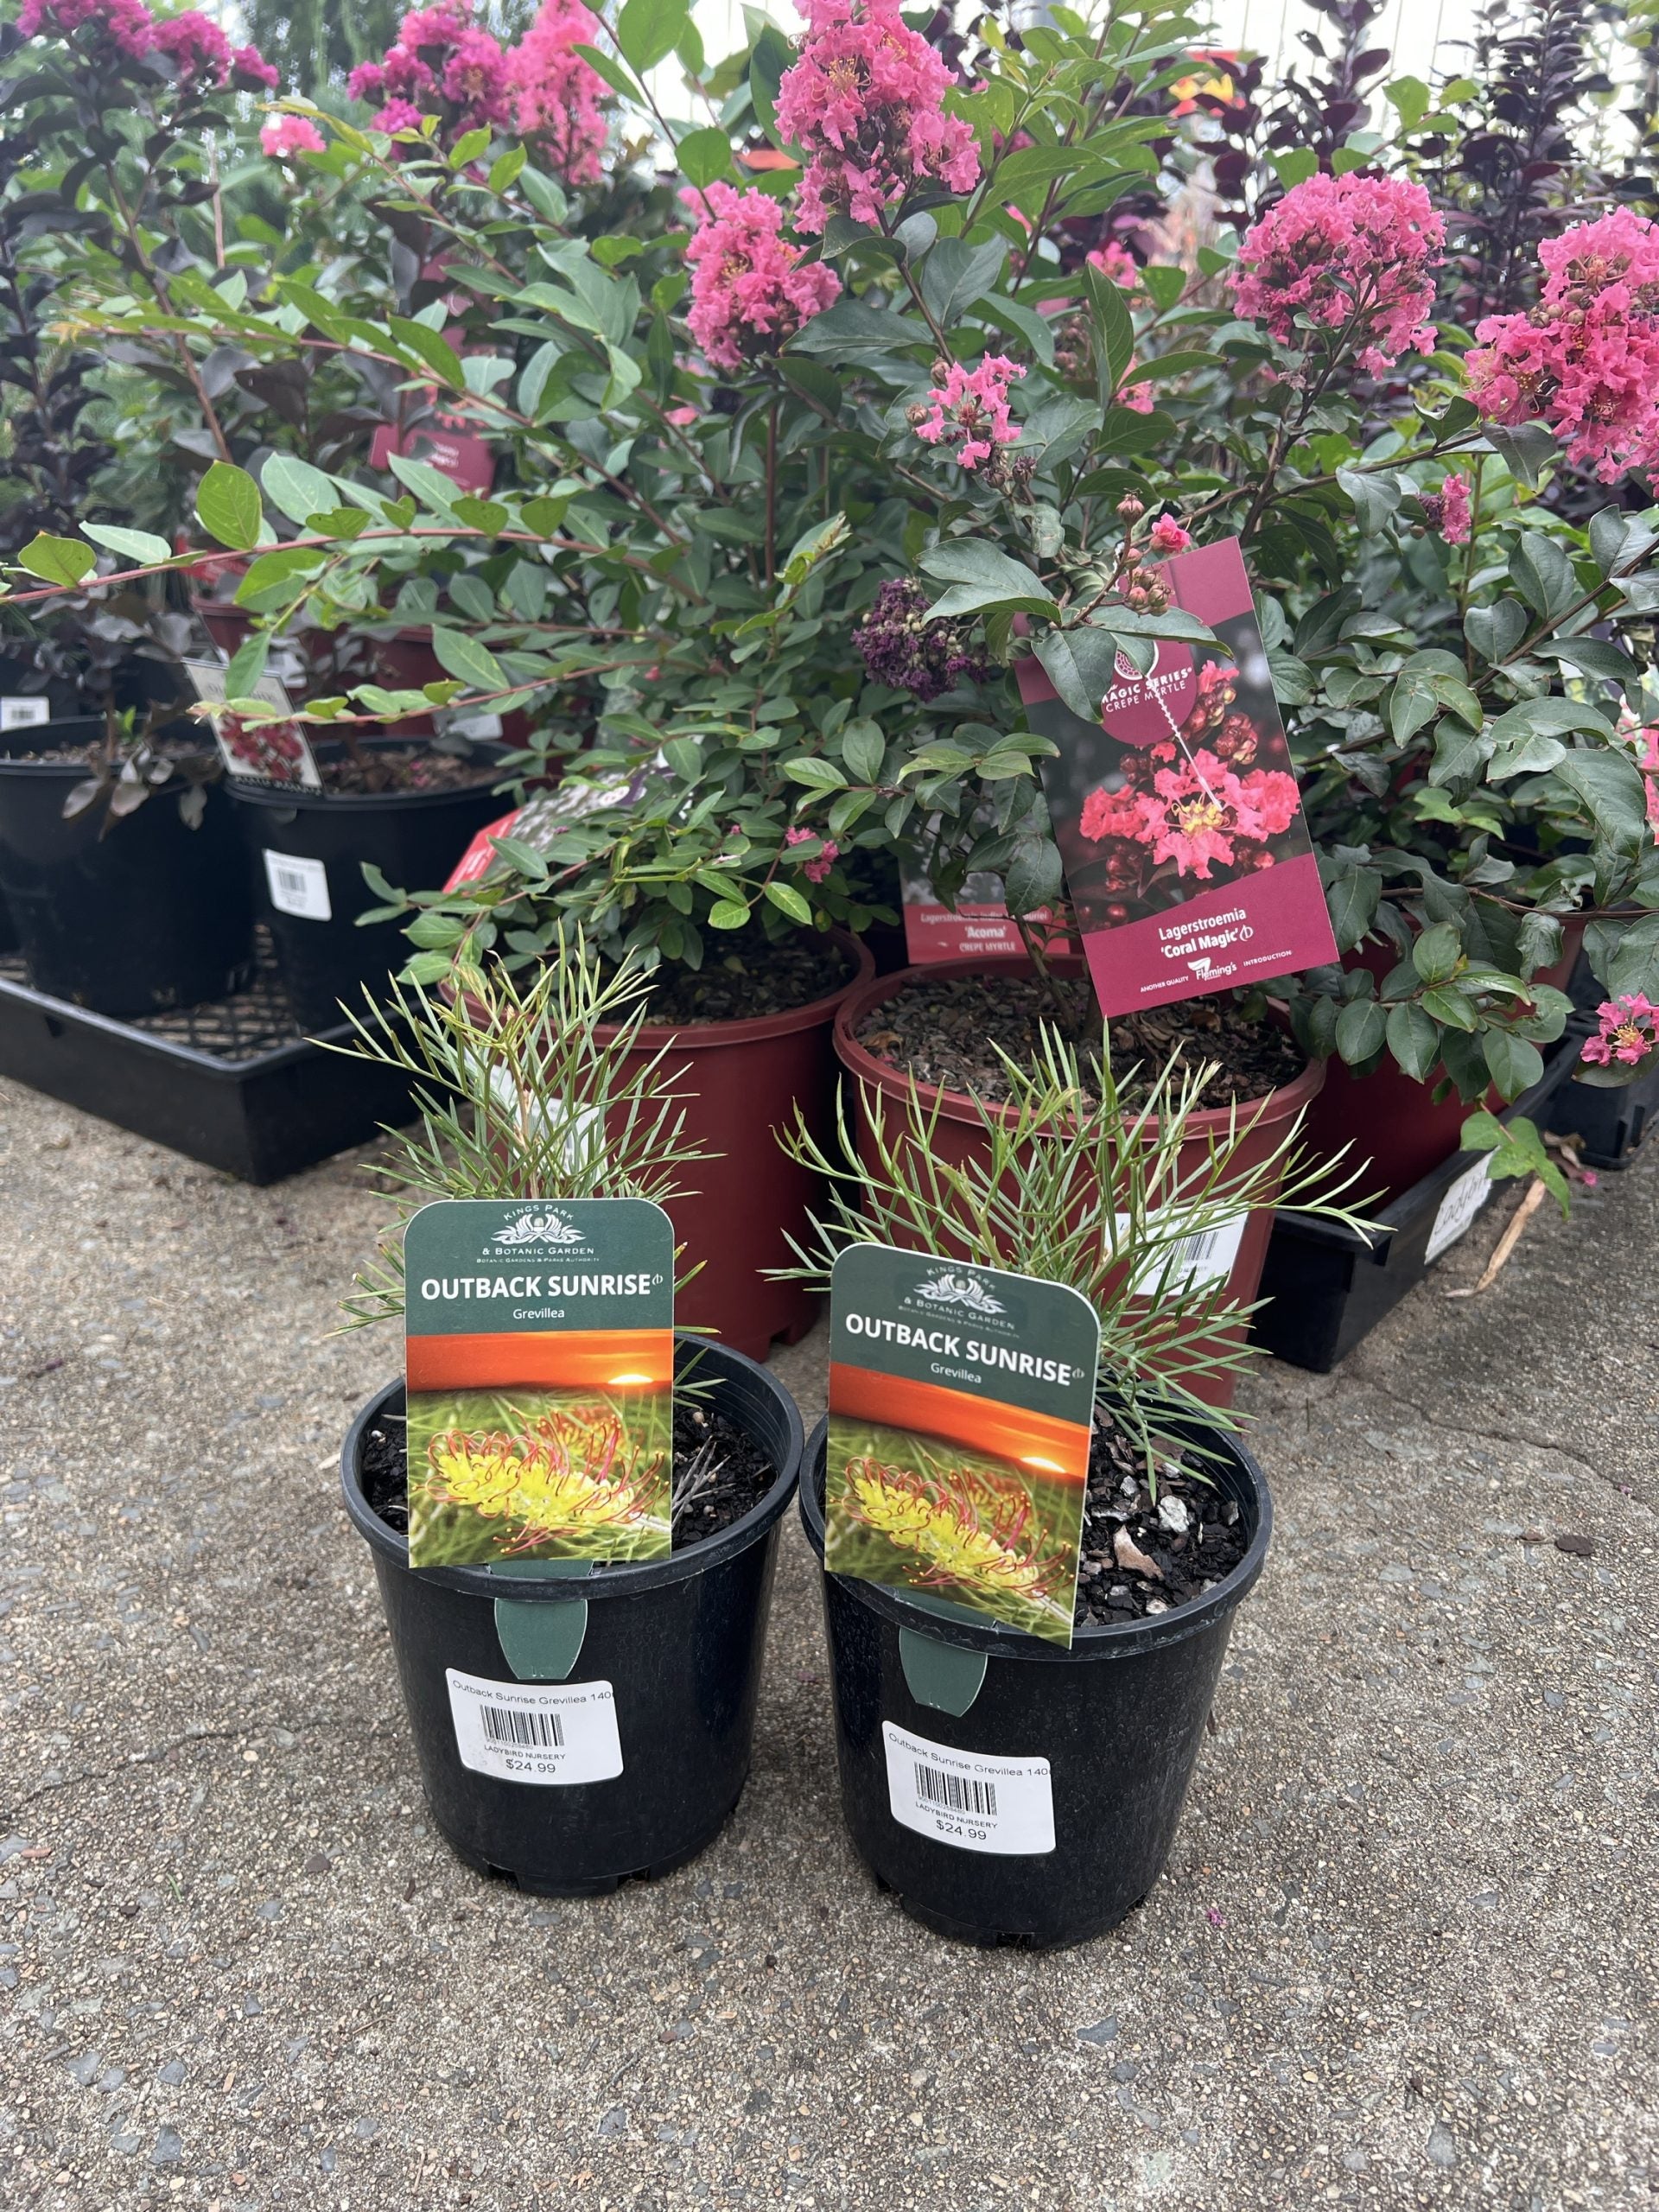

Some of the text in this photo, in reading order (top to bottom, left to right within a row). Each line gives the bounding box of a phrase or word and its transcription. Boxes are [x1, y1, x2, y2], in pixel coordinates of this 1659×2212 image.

[1105, 680, 1185, 713] CREPE MRTLE
[1159, 907, 1247, 941] Lagerstroemia
[959, 941, 1016, 953] CREPE MYRTLE
[1160, 927, 1239, 958] 'Coral Magic'
[1140, 950, 1293, 993] ANOTHER QUALITY Fleming's INTRODUCTION
[503, 1205, 575, 1221] KINGS PARK
[482, 1246, 594, 1255] & BOTANIC GARDEN
[421, 1274, 651, 1300] OUTBACK SUNRISE
[926, 1266, 996, 1290] KINGS PARK
[512, 1307, 565, 1320] Grevillea
[904, 1296, 1016, 1331] & BOTANIC GARDEN
[845, 1313, 1071, 1387] OUTBACK SUNRISE
[931, 1363, 982, 1384] Grevillea
[453, 1680, 614, 1706] Outback Sunrise Grevillea 140
[484, 1744, 524, 1758] LADYBIRD
[888, 1732, 1051, 1777] Outback Sunrise Grevillea 140
[505, 1758, 556, 1773] $24.99
[915, 1802, 955, 1821] LADYBIRD
[957, 1816, 998, 1829] NURSERY
[936, 1819, 987, 1840] $24.99
